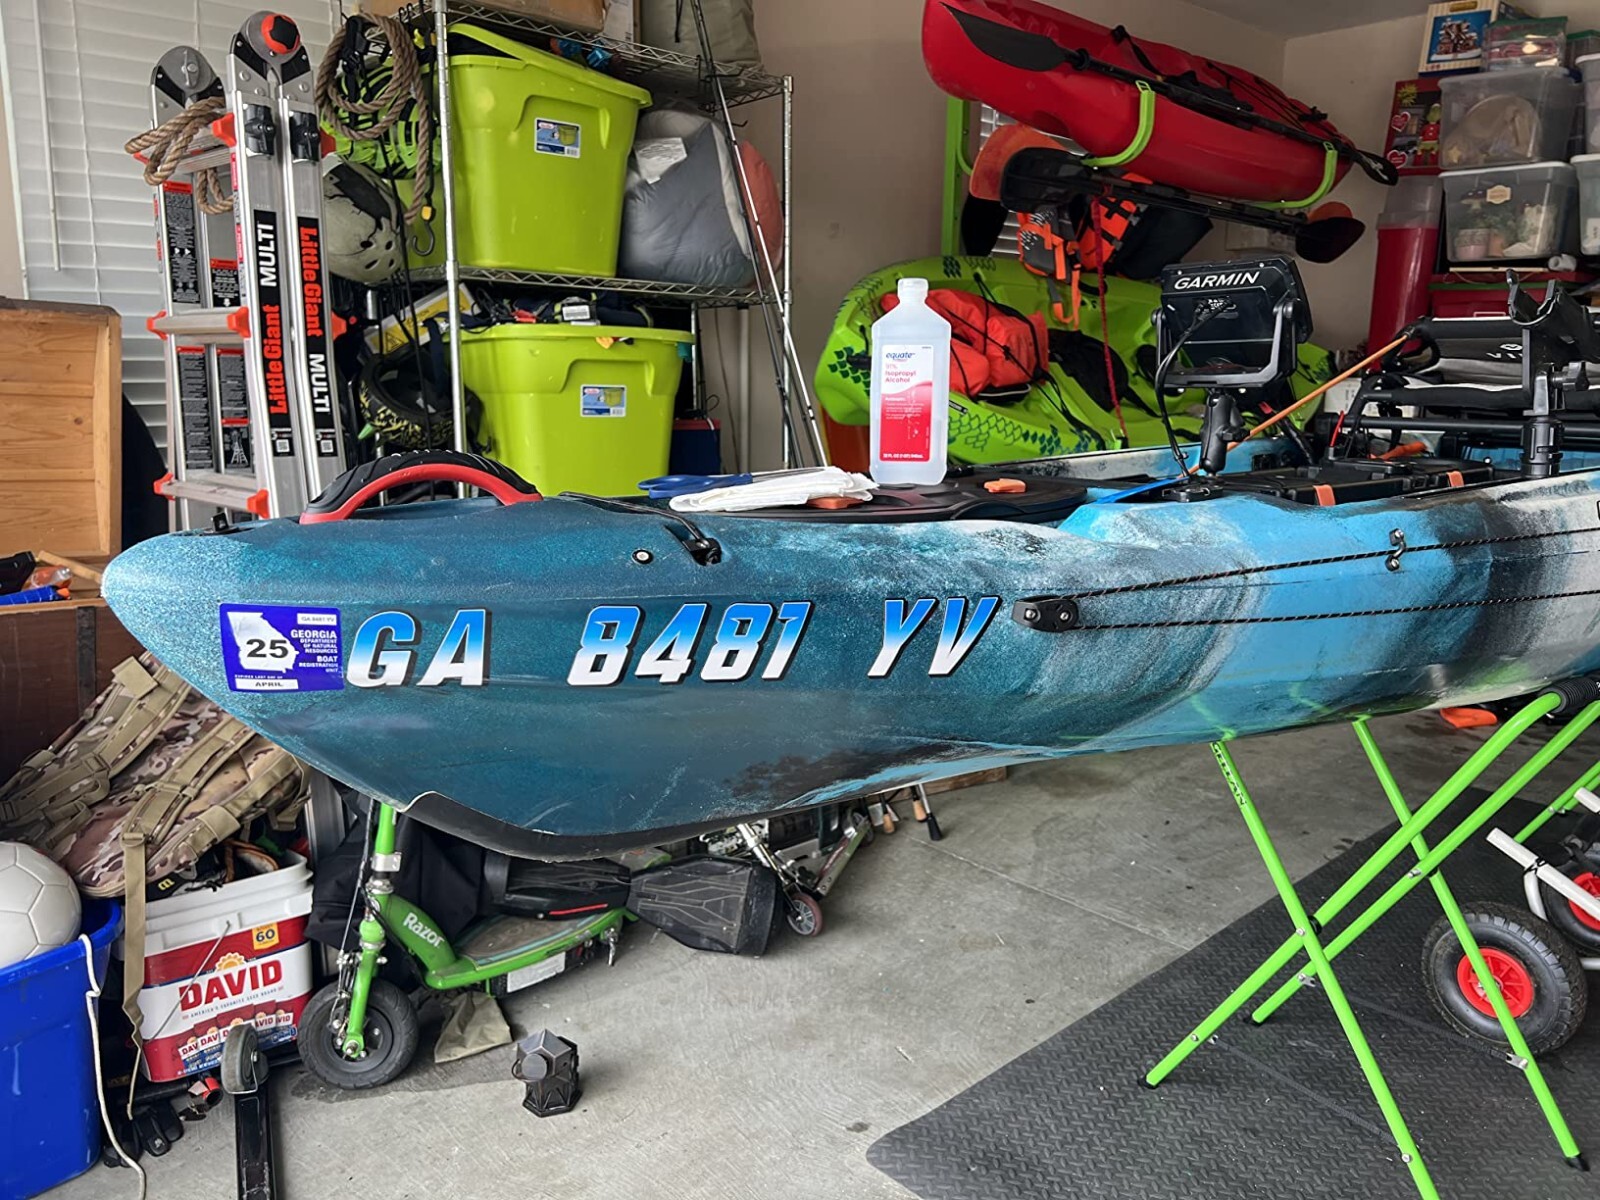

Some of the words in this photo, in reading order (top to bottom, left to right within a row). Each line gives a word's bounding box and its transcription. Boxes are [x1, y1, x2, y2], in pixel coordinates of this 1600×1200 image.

[257, 223, 278, 288] MULTI
[1174, 271, 1260, 290] GARMIN
[885, 351, 914, 360] equate
[309, 353, 331, 414] MULTI
[290, 629, 338, 639] GEORGIA
[346, 607, 492, 688] GA
[566, 603, 814, 687] 8481
[867, 597, 1002, 678] YV
[246, 638, 289, 659] 25
[256, 929, 275, 942] 60
[403, 911, 445, 947] Razor
[179, 959, 283, 1012] DAVID
